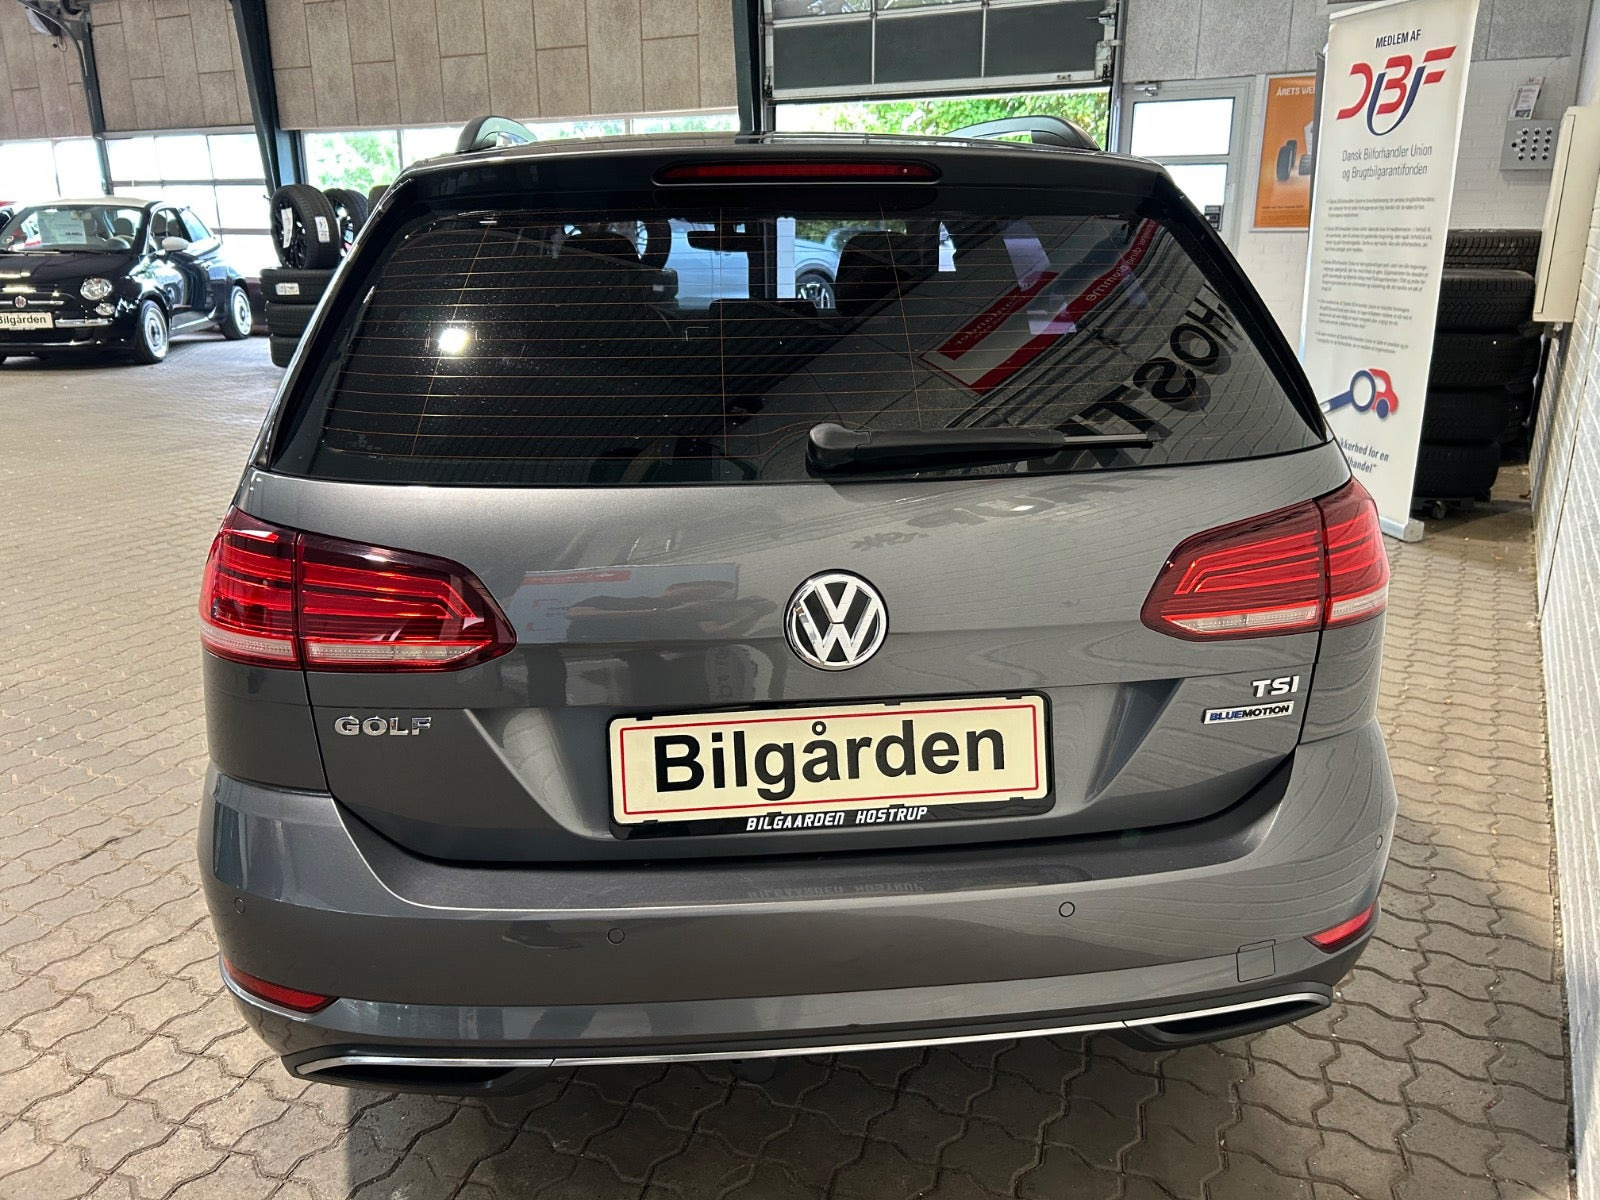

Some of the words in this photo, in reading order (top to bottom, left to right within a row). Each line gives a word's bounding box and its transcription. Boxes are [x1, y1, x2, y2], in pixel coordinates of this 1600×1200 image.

[1375, 32, 1409, 49] MEDLEM
[1410, 29, 1422, 42] AF
[1342, 149, 1362, 162] Dansk
[1363, 145, 1409, 161] Bilforhandler
[1410, 143, 1433, 157] Union
[1342, 169, 1350, 181] og
[1351, 162, 1428, 181] Brugtbilgarantifonden
[1340, 437, 1368, 455] kkerhed
[1368, 447, 1379, 459] for
[1379, 452, 1390, 462] en
[1252, 675, 1299, 698] TSI
[1209, 704, 1290, 721] BLUEMOTION
[334, 715, 432, 737] GOLF
[653, 719, 1006, 801] Bilgården
[746, 811, 845, 831] BILGAARDEN
[855, 806, 928, 825] HOSTRUP
